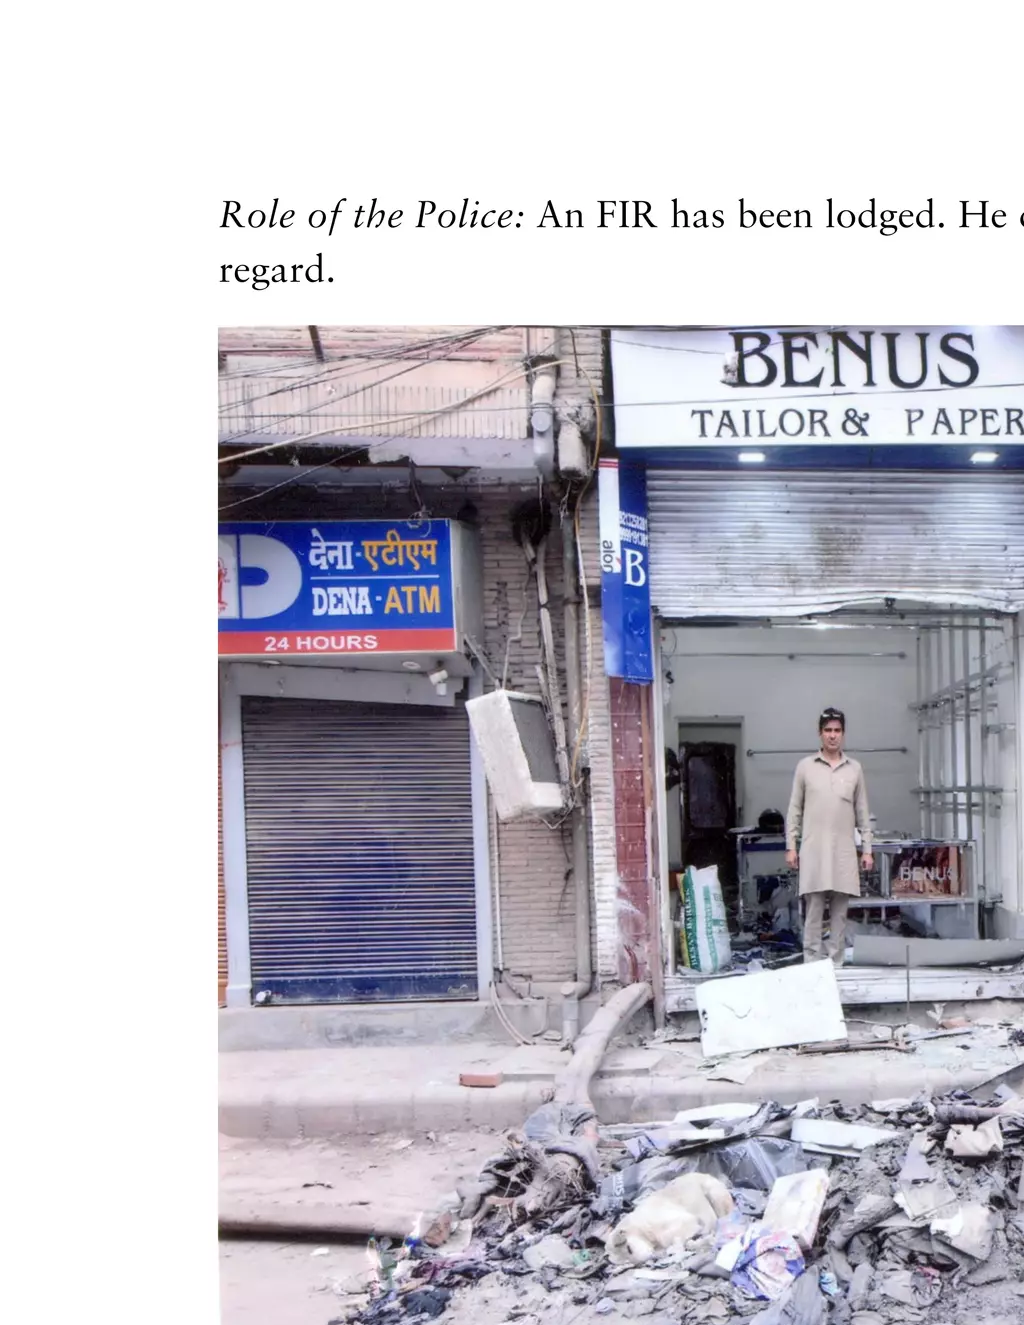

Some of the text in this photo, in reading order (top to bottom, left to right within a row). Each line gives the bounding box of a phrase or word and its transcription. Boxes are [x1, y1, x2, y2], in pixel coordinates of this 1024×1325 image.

[219, 252, 334, 291] regard.
[727, 330, 980, 389] BENUS
[691, 408, 832, 438] TAILOR
[841, 406, 871, 438] &
[264, 635, 378, 651] 24 HOURS
